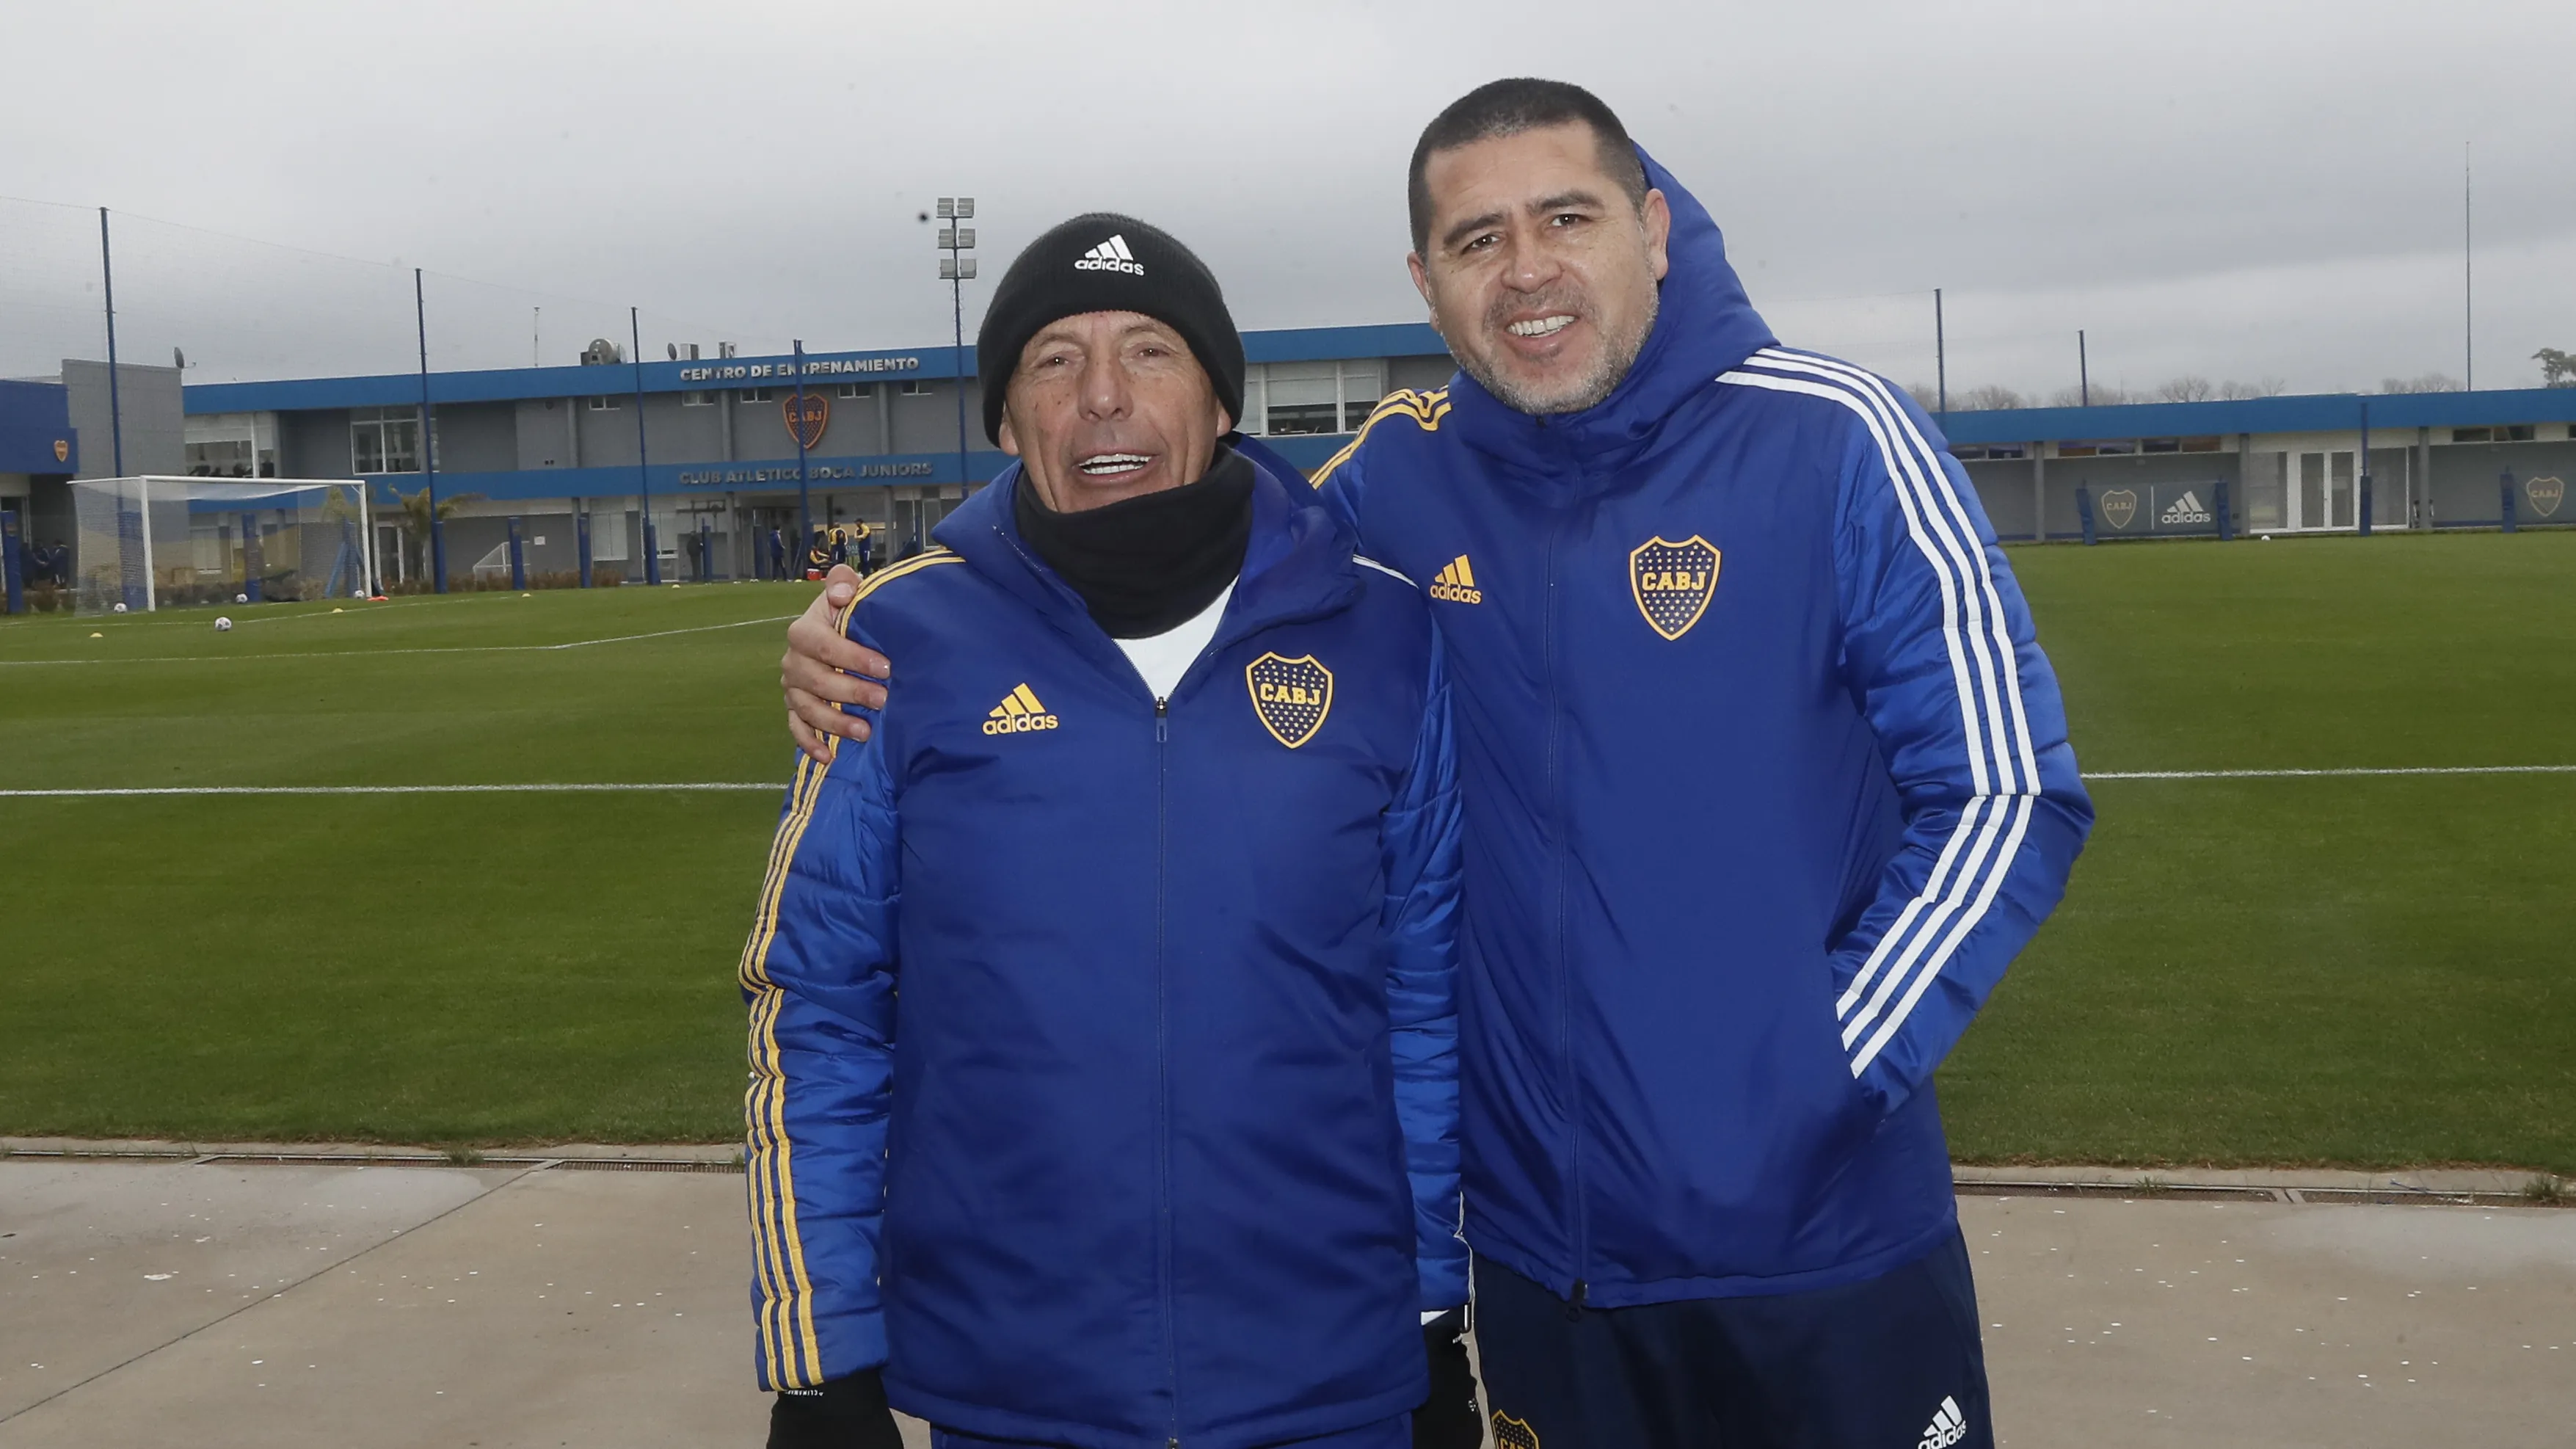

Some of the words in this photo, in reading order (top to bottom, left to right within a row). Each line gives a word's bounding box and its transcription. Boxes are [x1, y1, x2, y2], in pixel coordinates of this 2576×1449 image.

[1074, 256, 1145, 276] adidas
[680, 366, 746, 381] CENTRO
[751, 364, 773, 378] DE
[777, 357, 919, 377] ENTRENAMIENTO
[680, 470, 721, 484] CLUB
[809, 467, 856, 479] BOCA
[860, 462, 934, 477] JUNIORS
[2106, 502, 2132, 511] CABJ
[2161, 512, 2212, 524] adidas
[1642, 571, 1706, 591] CABJ
[1430, 582, 1482, 605] adidas
[1259, 682, 1321, 705] CABJ
[982, 713, 1059, 736] adidas
[1917, 1420, 1967, 1449] adidas
